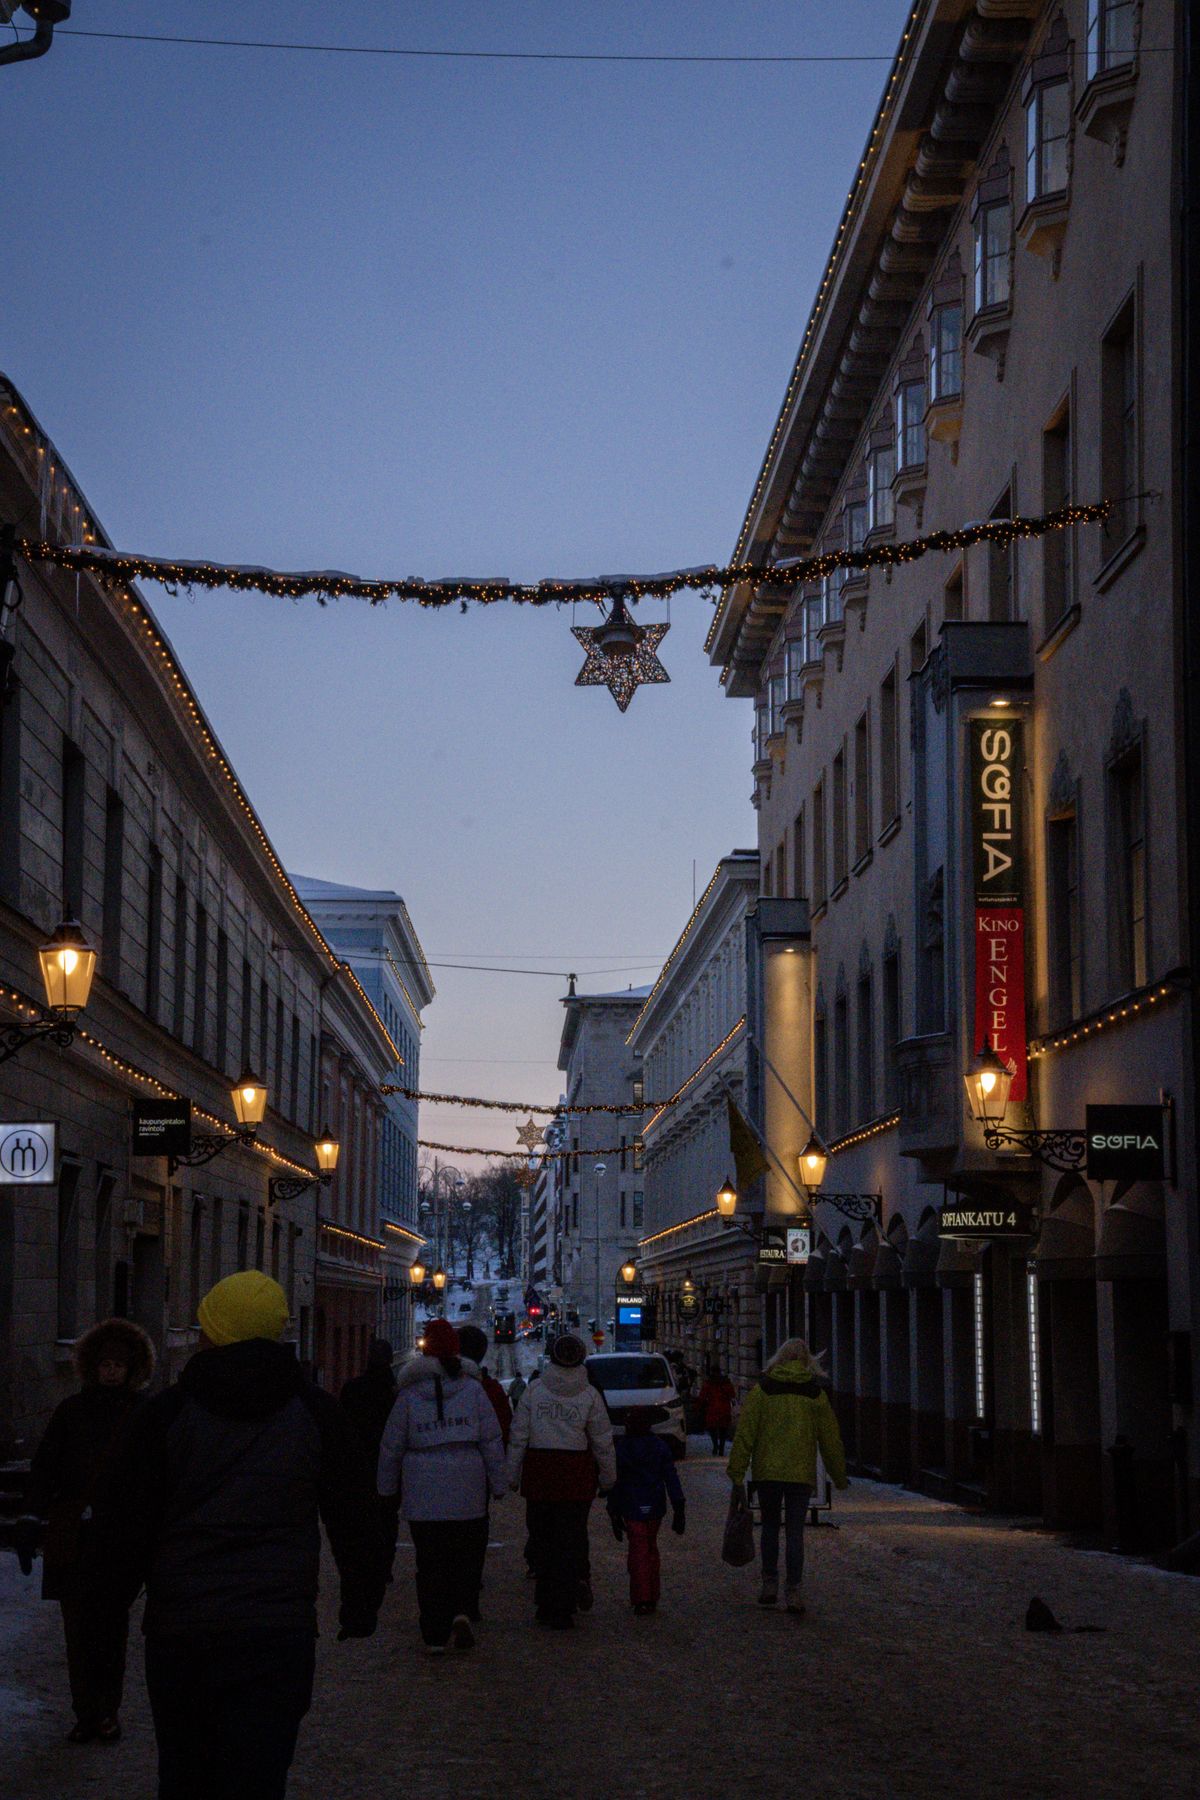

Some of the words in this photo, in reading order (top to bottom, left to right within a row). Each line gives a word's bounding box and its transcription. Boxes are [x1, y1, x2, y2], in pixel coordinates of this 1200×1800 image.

[980, 729, 1012, 882] SOFIA
[988, 938, 1008, 1052] ENGEL
[1091, 1135, 1159, 1149] SOFIA
[942, 1211, 1004, 1226] SOFIANKATU
[1006, 1212, 1017, 1226] 4
[705, 1300, 722, 1311] WC
[536, 1403, 582, 1421] FILA
[416, 1417, 471, 1432] EXTREME
